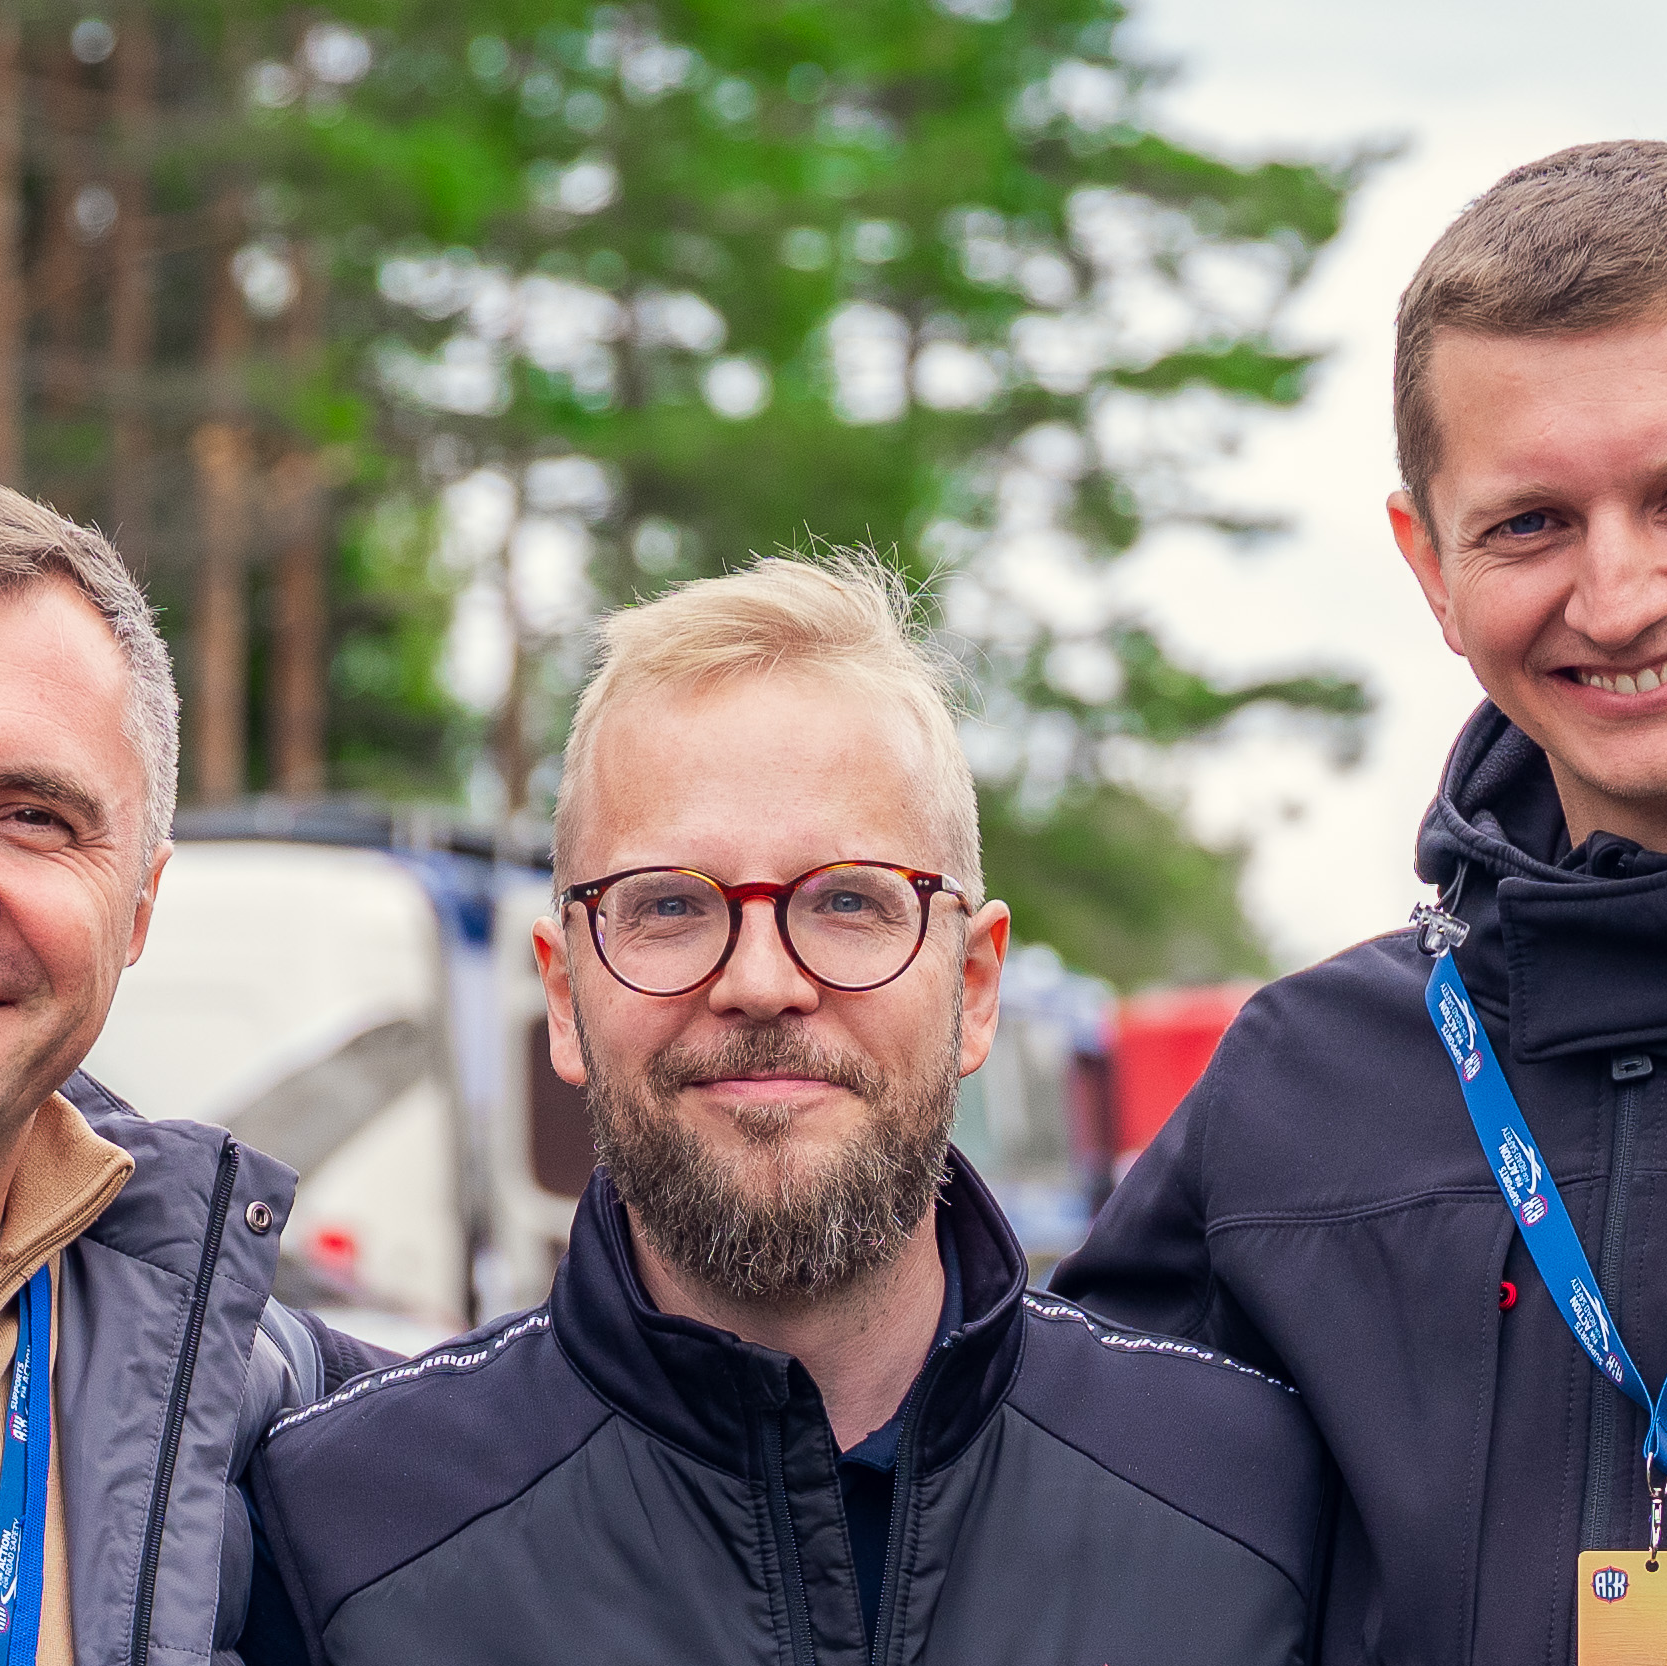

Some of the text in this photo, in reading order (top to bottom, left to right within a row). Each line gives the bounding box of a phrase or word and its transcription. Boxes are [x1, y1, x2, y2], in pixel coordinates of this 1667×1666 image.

[1440, 982, 1455, 1009] SAFETY
[1439, 999, 1458, 1032] ACTION
[1452, 1007, 1464, 1029] ROAD
[1441, 1023, 1464, 1064] SUPPORTS
[1501, 1126, 1519, 1153] SAFETY
[1499, 1142, 1524, 1188] FIA ACTION
[1514, 1152, 1528, 1173] ROAD
[1498, 1165, 1521, 1207] SUPPORTS
[1522, 1196, 1545, 1224] AKK
[1570, 1278, 1587, 1304] SAFETY
[1570, 1295, 1599, 1345] FIA ACTION
[1584, 1305, 1597, 1328] ROAD
[1574, 1321, 1603, 1366] SUPPORTS
[1605, 1355, 1623, 1382] AKK
[10, 1361, 25, 1411] SUPPORTS
[8, 1518, 20, 1552] SAFETY
[4, 1552, 16, 1577] ROAD
[1594, 1572, 1626, 1598] AKK
